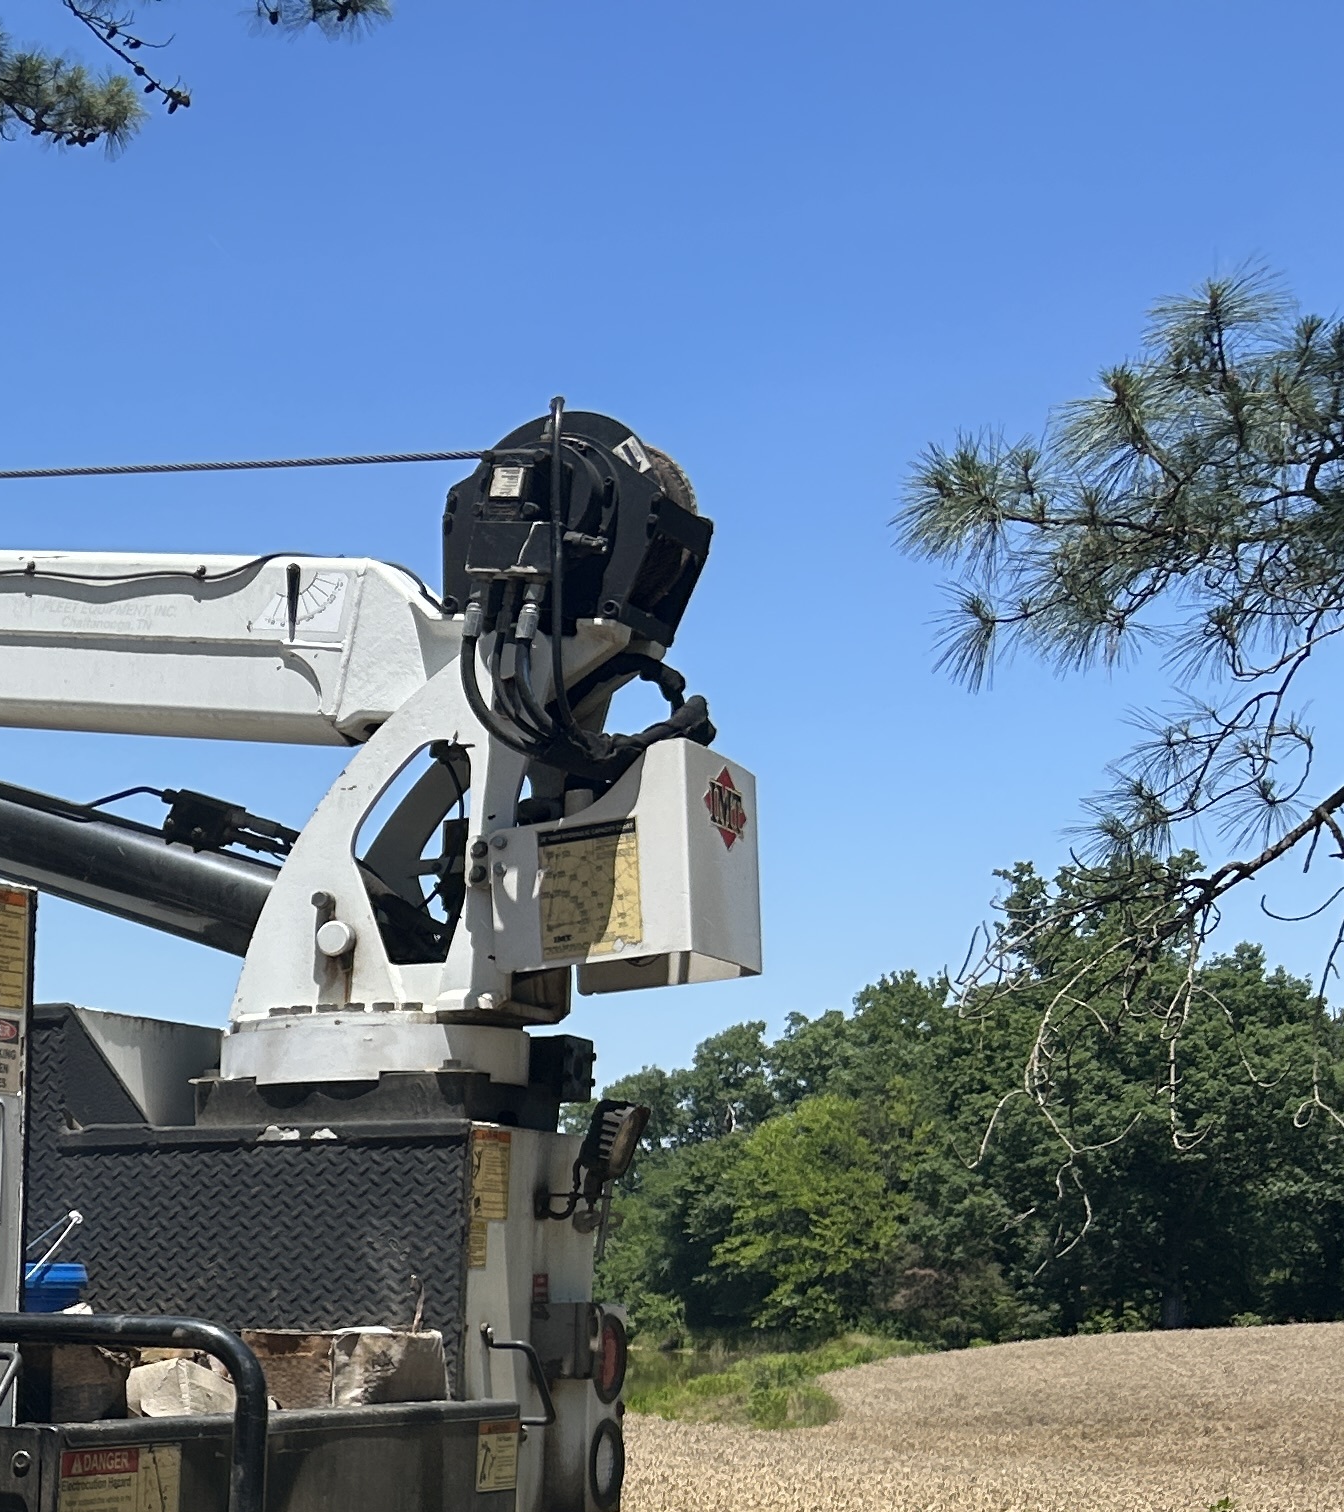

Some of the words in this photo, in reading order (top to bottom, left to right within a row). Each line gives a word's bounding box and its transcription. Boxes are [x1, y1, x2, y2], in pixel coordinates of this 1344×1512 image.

[709, 780, 742, 834] IMT
[83, 1451, 130, 1471] DANGER
[61, 1478, 107, 1492] Electrocution
[108, 1476, 132, 1489] Hazard
